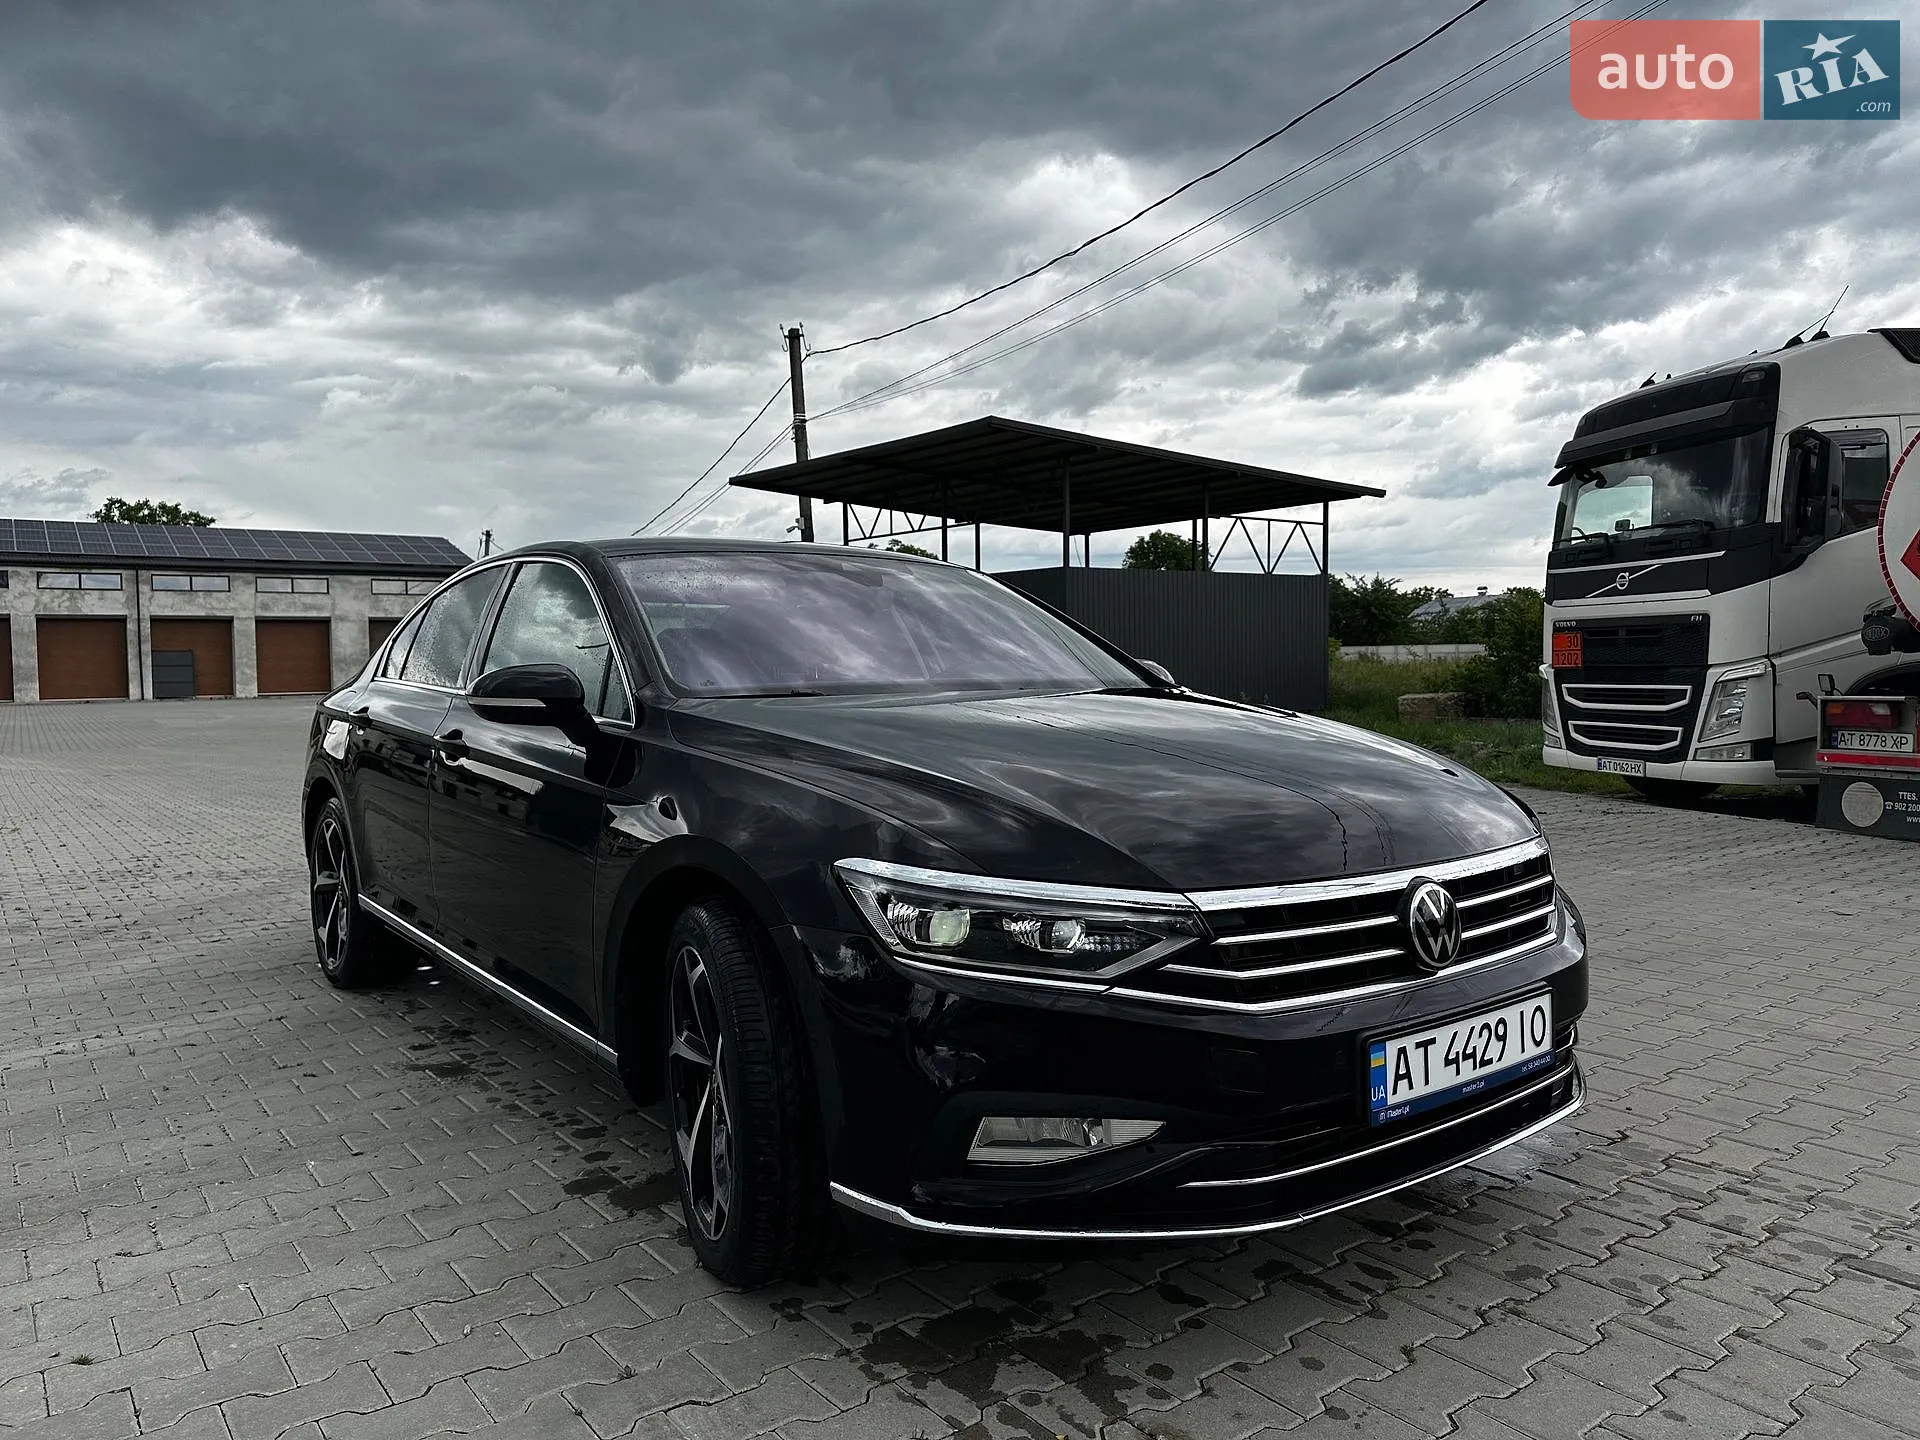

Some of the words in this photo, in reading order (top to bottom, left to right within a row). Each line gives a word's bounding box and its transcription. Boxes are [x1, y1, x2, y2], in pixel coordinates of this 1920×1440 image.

[1567, 635, 1579, 648] 30
[1555, 652, 1579, 666] 1202
[1838, 732, 1856, 746] AT
[1859, 733, 1887, 748] 8778
[1890, 735, 1909, 750] XP
[1602, 760, 1613, 771] AT
[1630, 763, 1642, 774] HX
[1391, 1036, 1437, 1096] AT
[1443, 1016, 1508, 1077] 4429
[1371, 1085, 1386, 1101] UA
